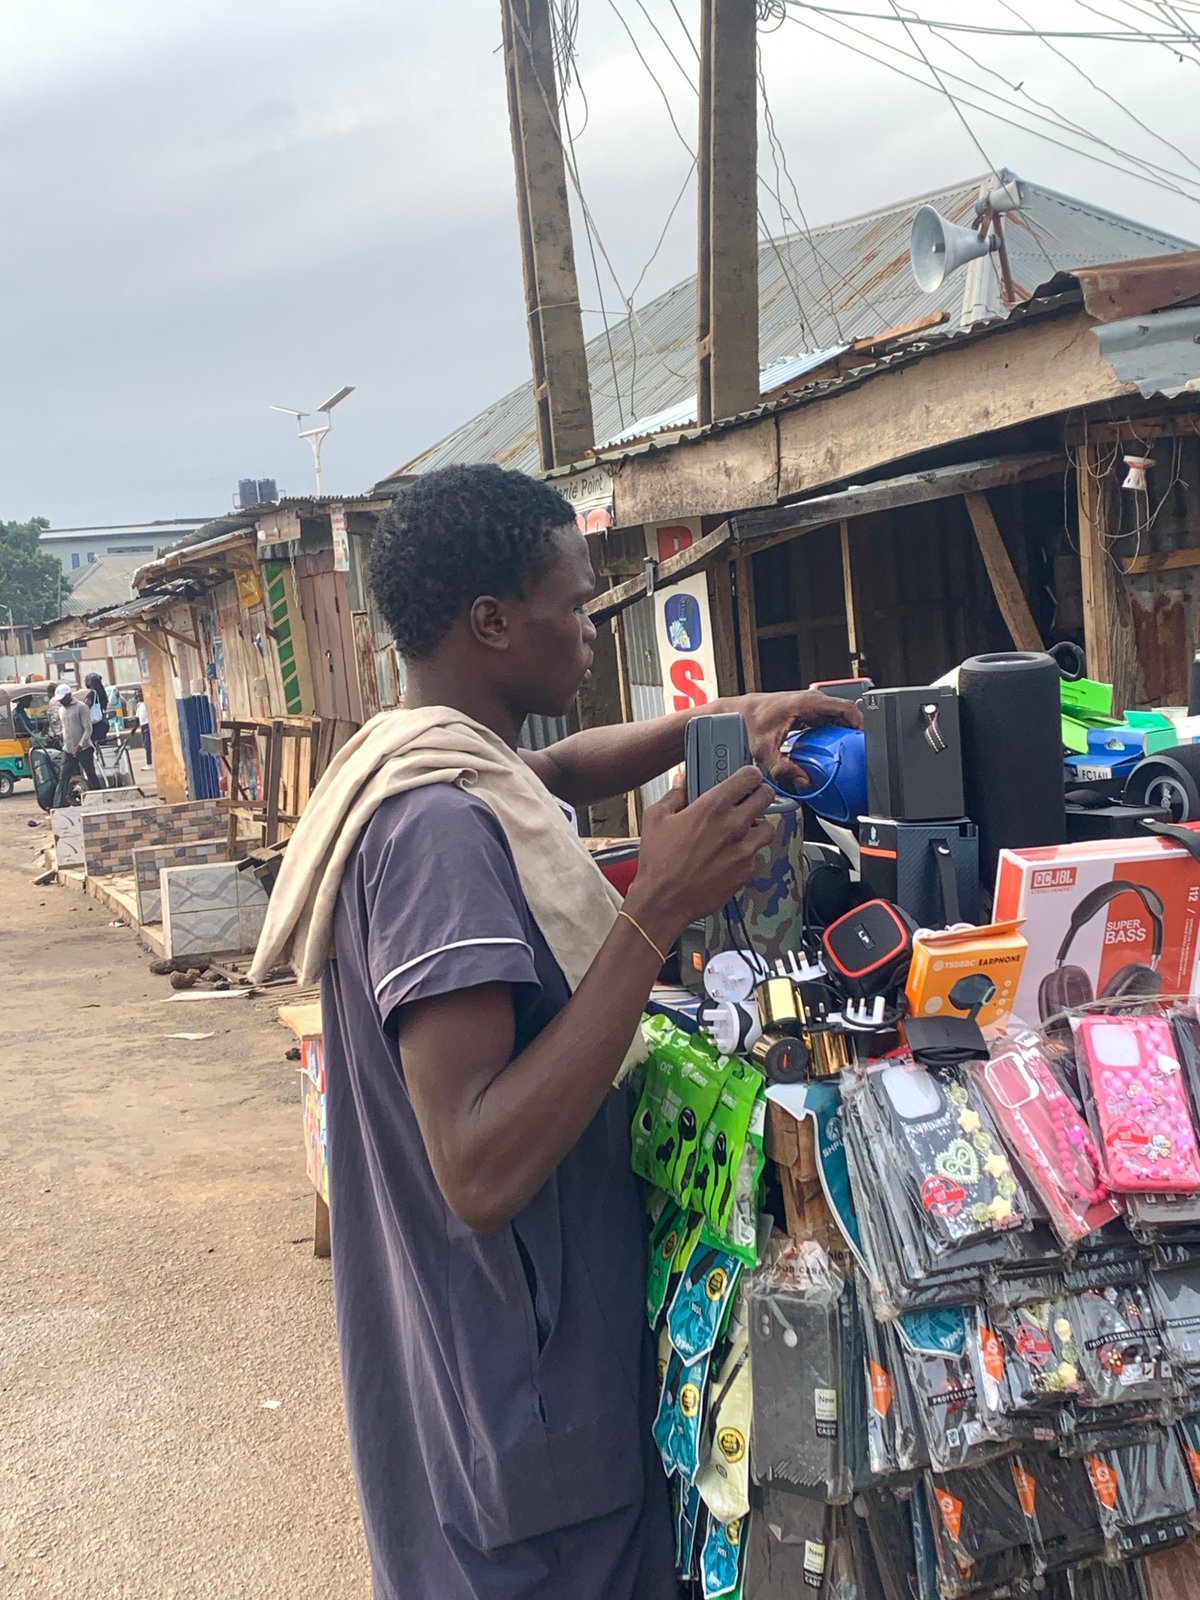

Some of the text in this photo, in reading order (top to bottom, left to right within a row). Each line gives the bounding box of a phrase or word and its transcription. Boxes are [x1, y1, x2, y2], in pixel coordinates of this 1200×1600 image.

[582, 473, 603, 496] Point
[1106, 919, 1141, 931] SUPER
[1104, 928, 1146, 944] BASS
[978, 955, 1021, 966] EARPHONE
[817, 1427, 837, 1436] CASE
